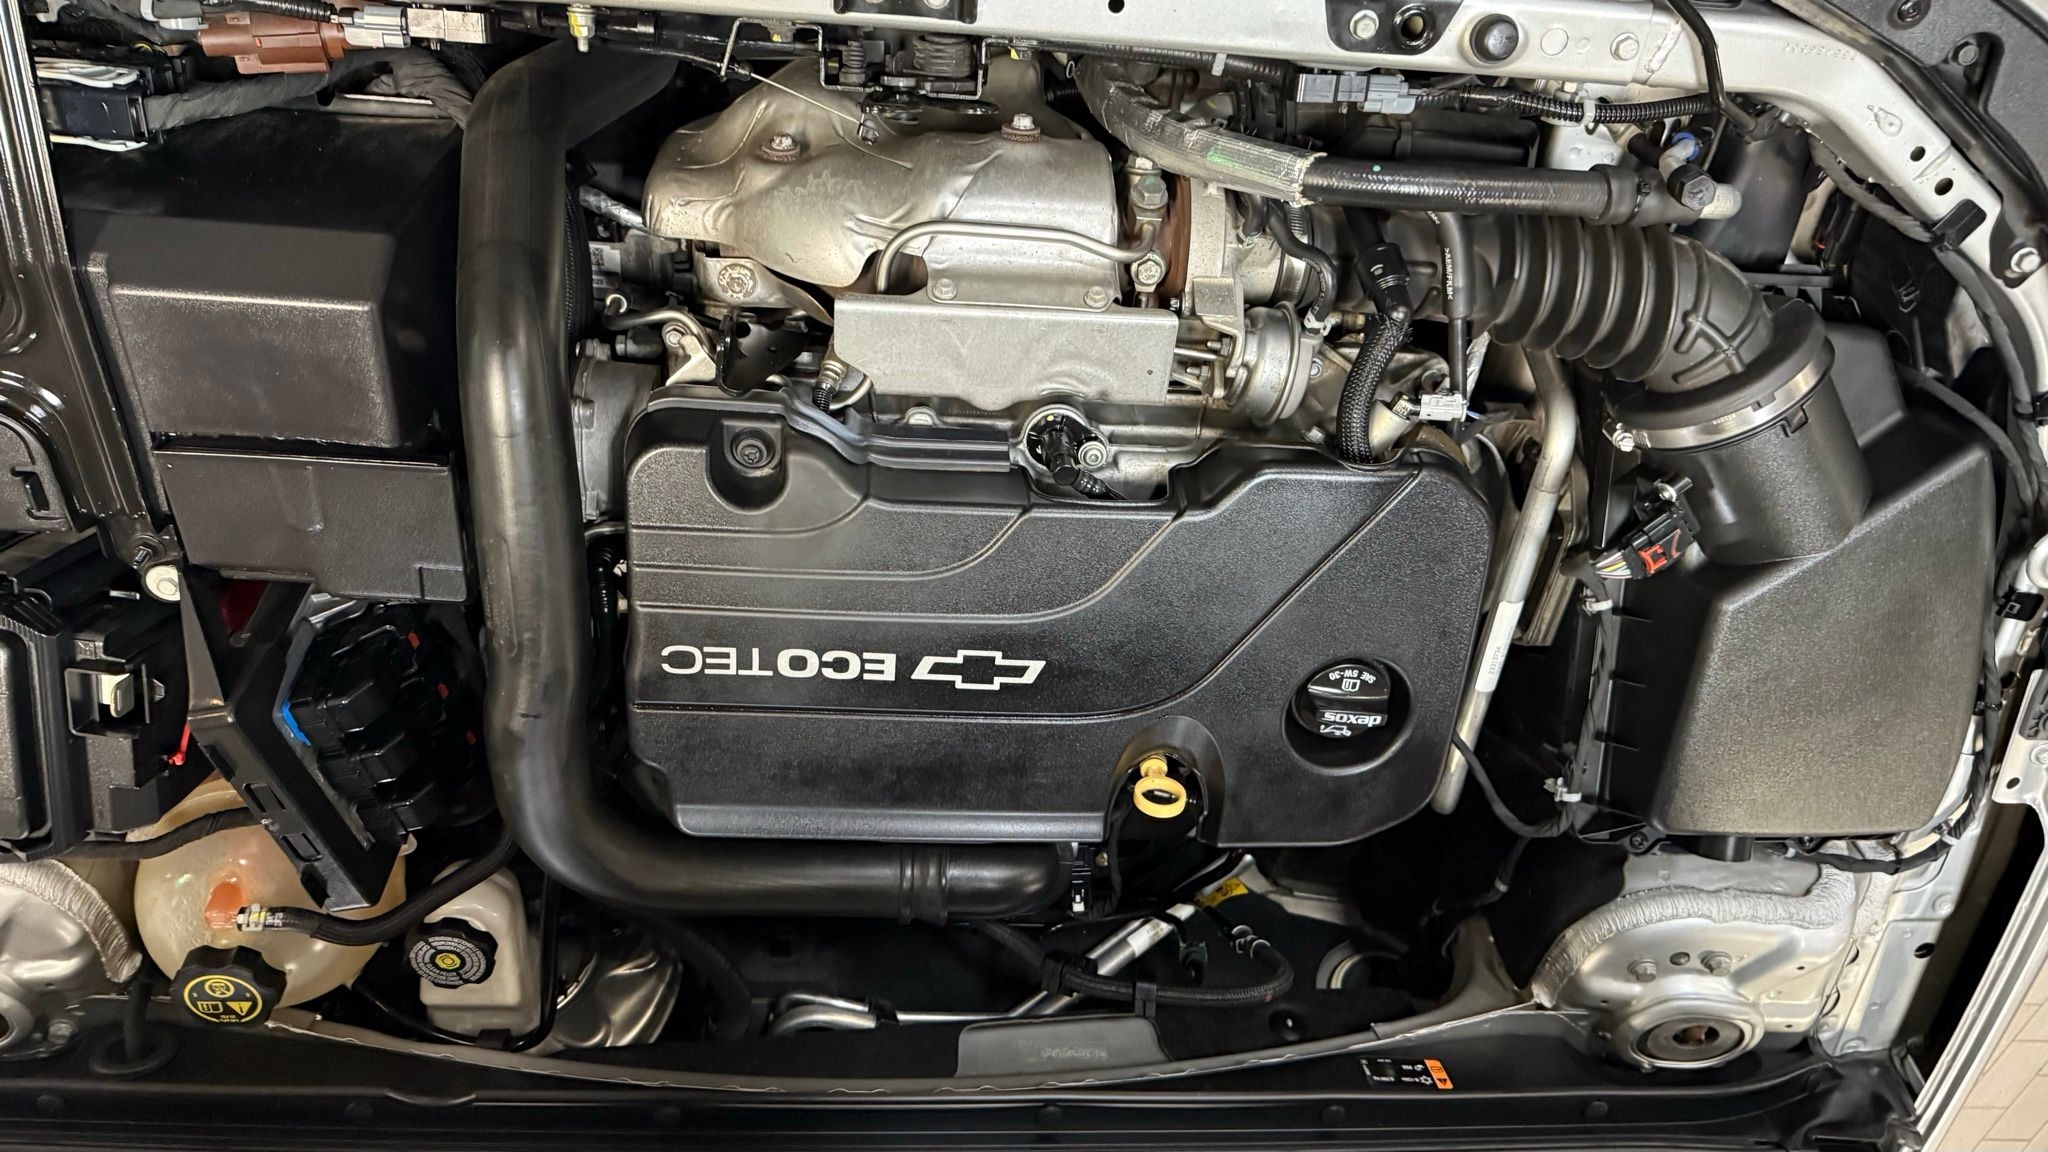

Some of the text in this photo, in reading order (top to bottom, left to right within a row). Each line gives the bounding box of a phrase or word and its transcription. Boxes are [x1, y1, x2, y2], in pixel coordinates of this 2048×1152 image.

[661, 645, 897, 682] ECOTEC
[1328, 669, 1377, 684] SAE 5W-30
[1322, 711, 1382, 727] dexos
